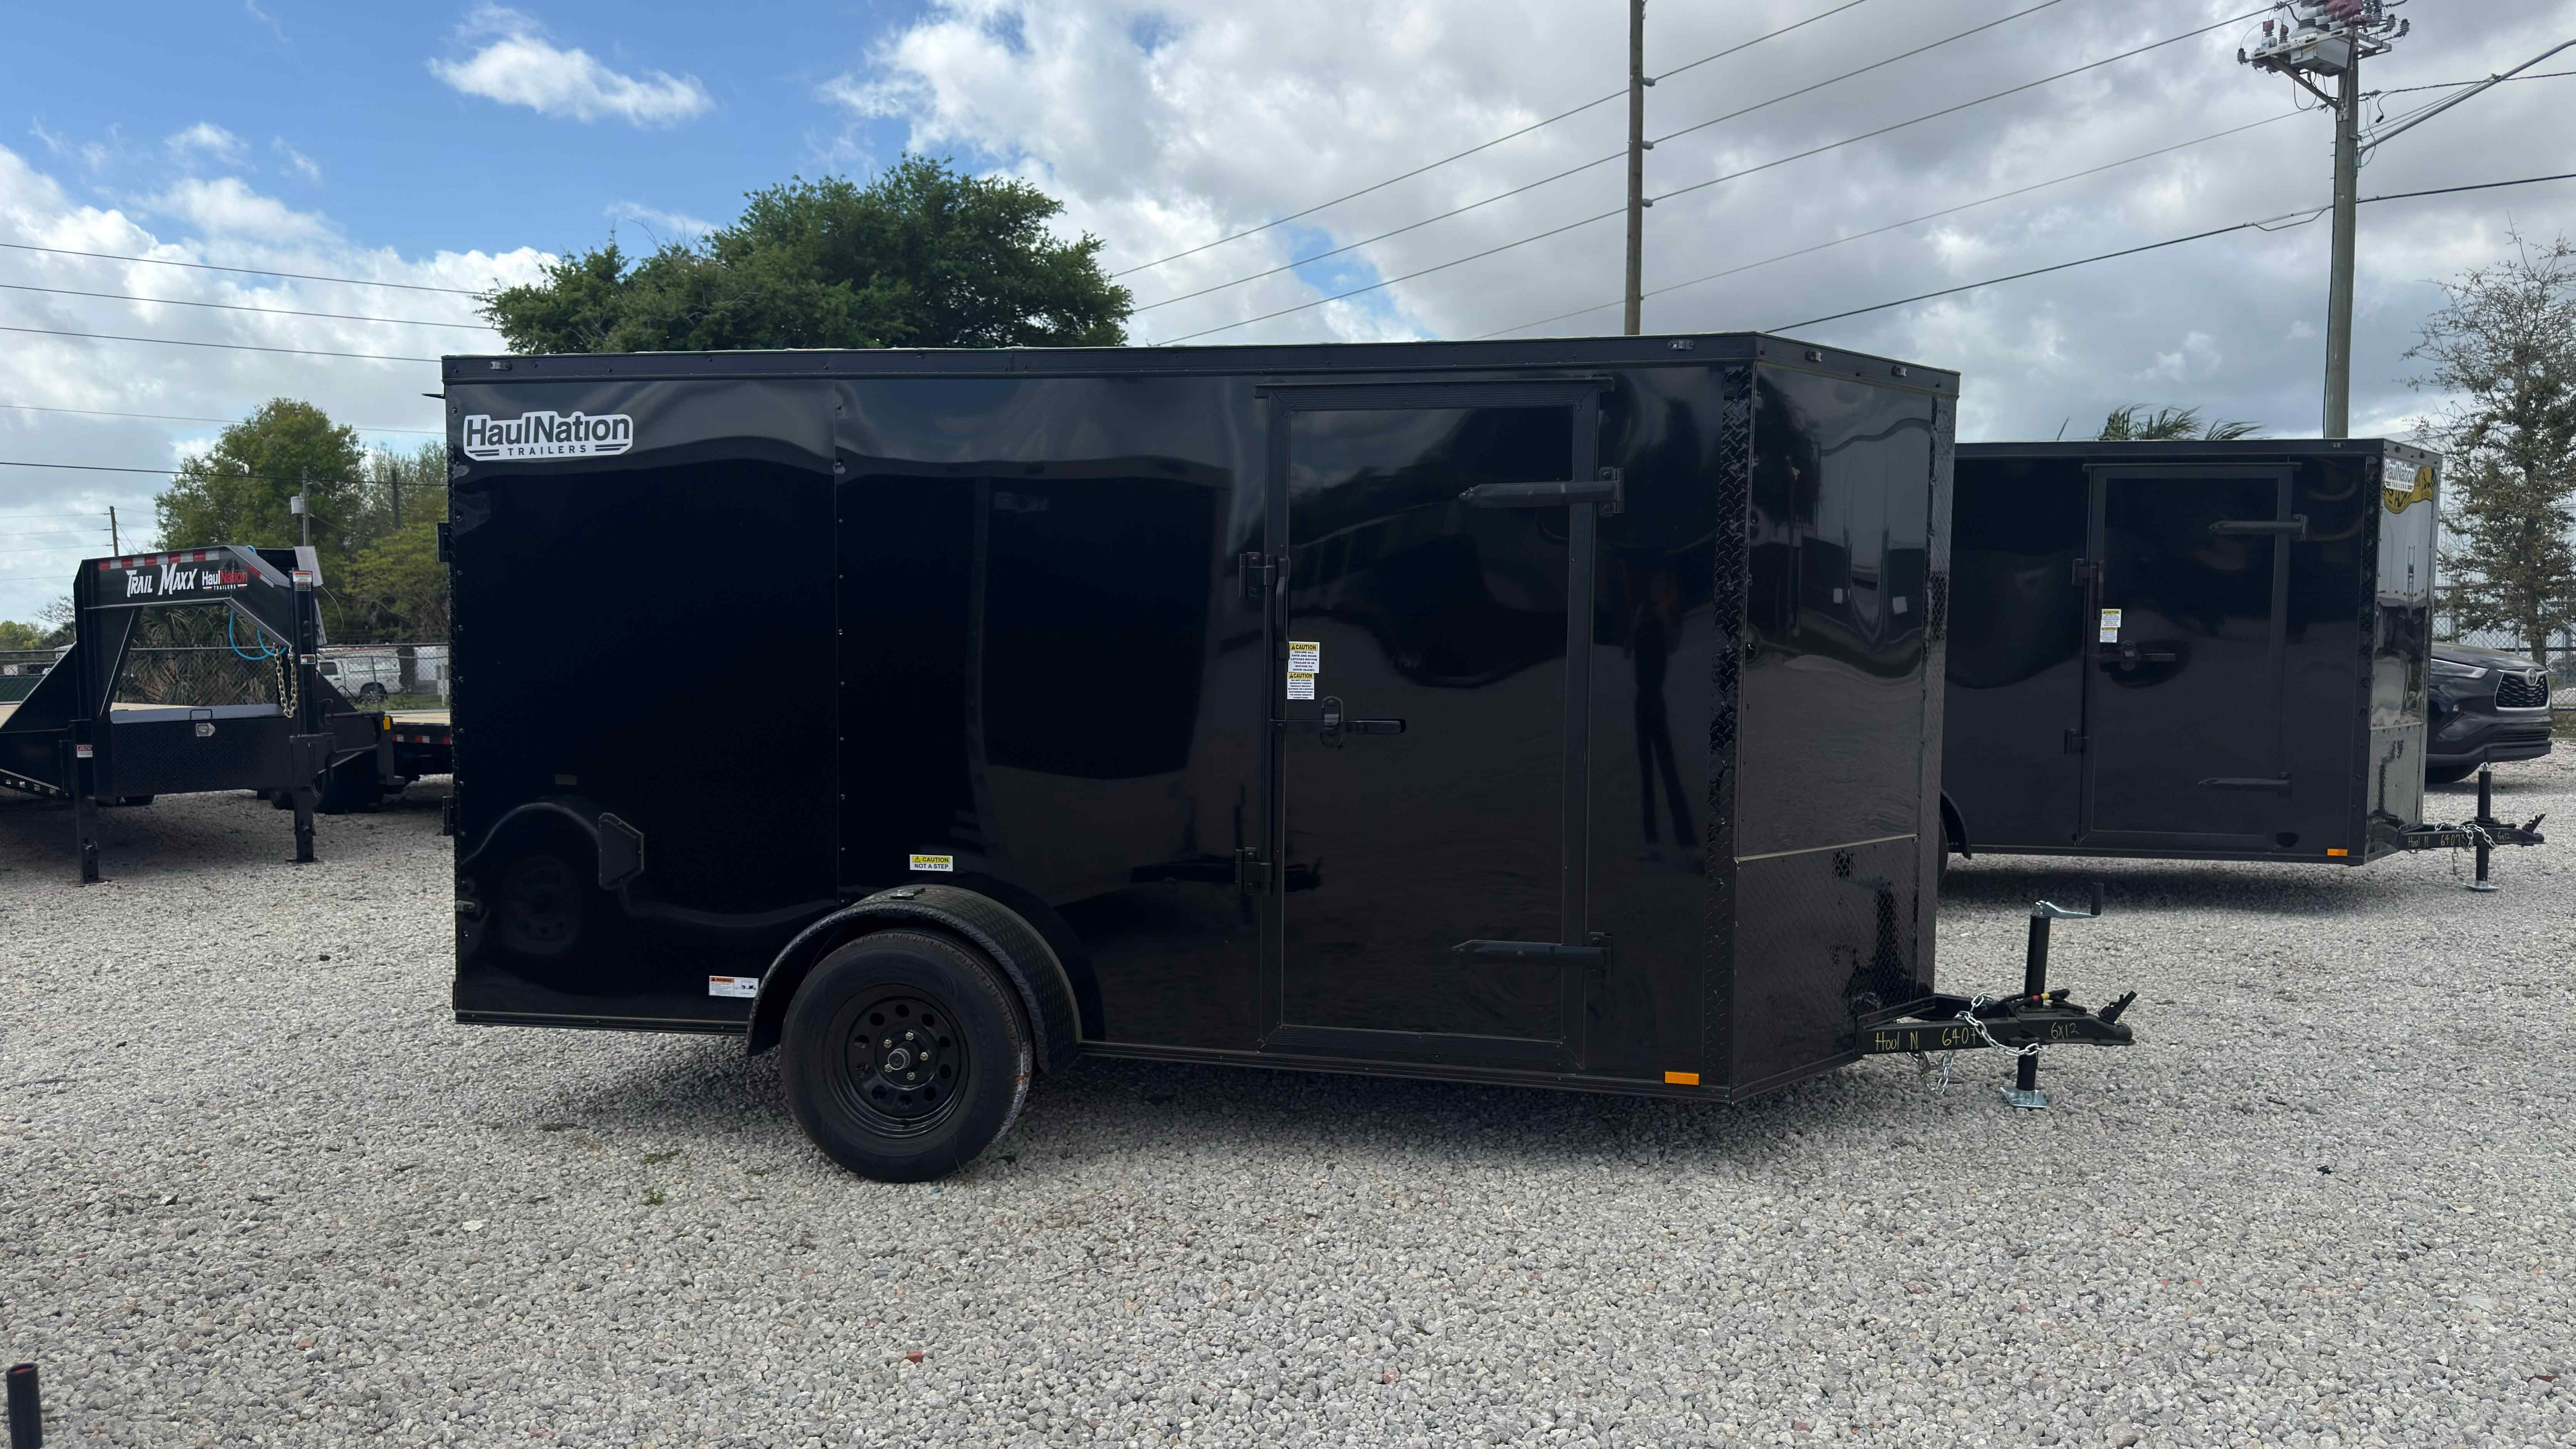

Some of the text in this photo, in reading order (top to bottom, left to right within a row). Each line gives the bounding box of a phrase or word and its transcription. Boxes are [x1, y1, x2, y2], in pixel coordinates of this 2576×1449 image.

[466, 415, 629, 447] HaulNation
[507, 444, 587, 456] TRAILERS
[2385, 461, 2415, 484] HaulNation
[126, 570, 153, 597] TRAIL
[202, 570, 248, 585] HaulNation
[2424, 835, 2428, 847] N
[1910, 1031, 1919, 1050] N
